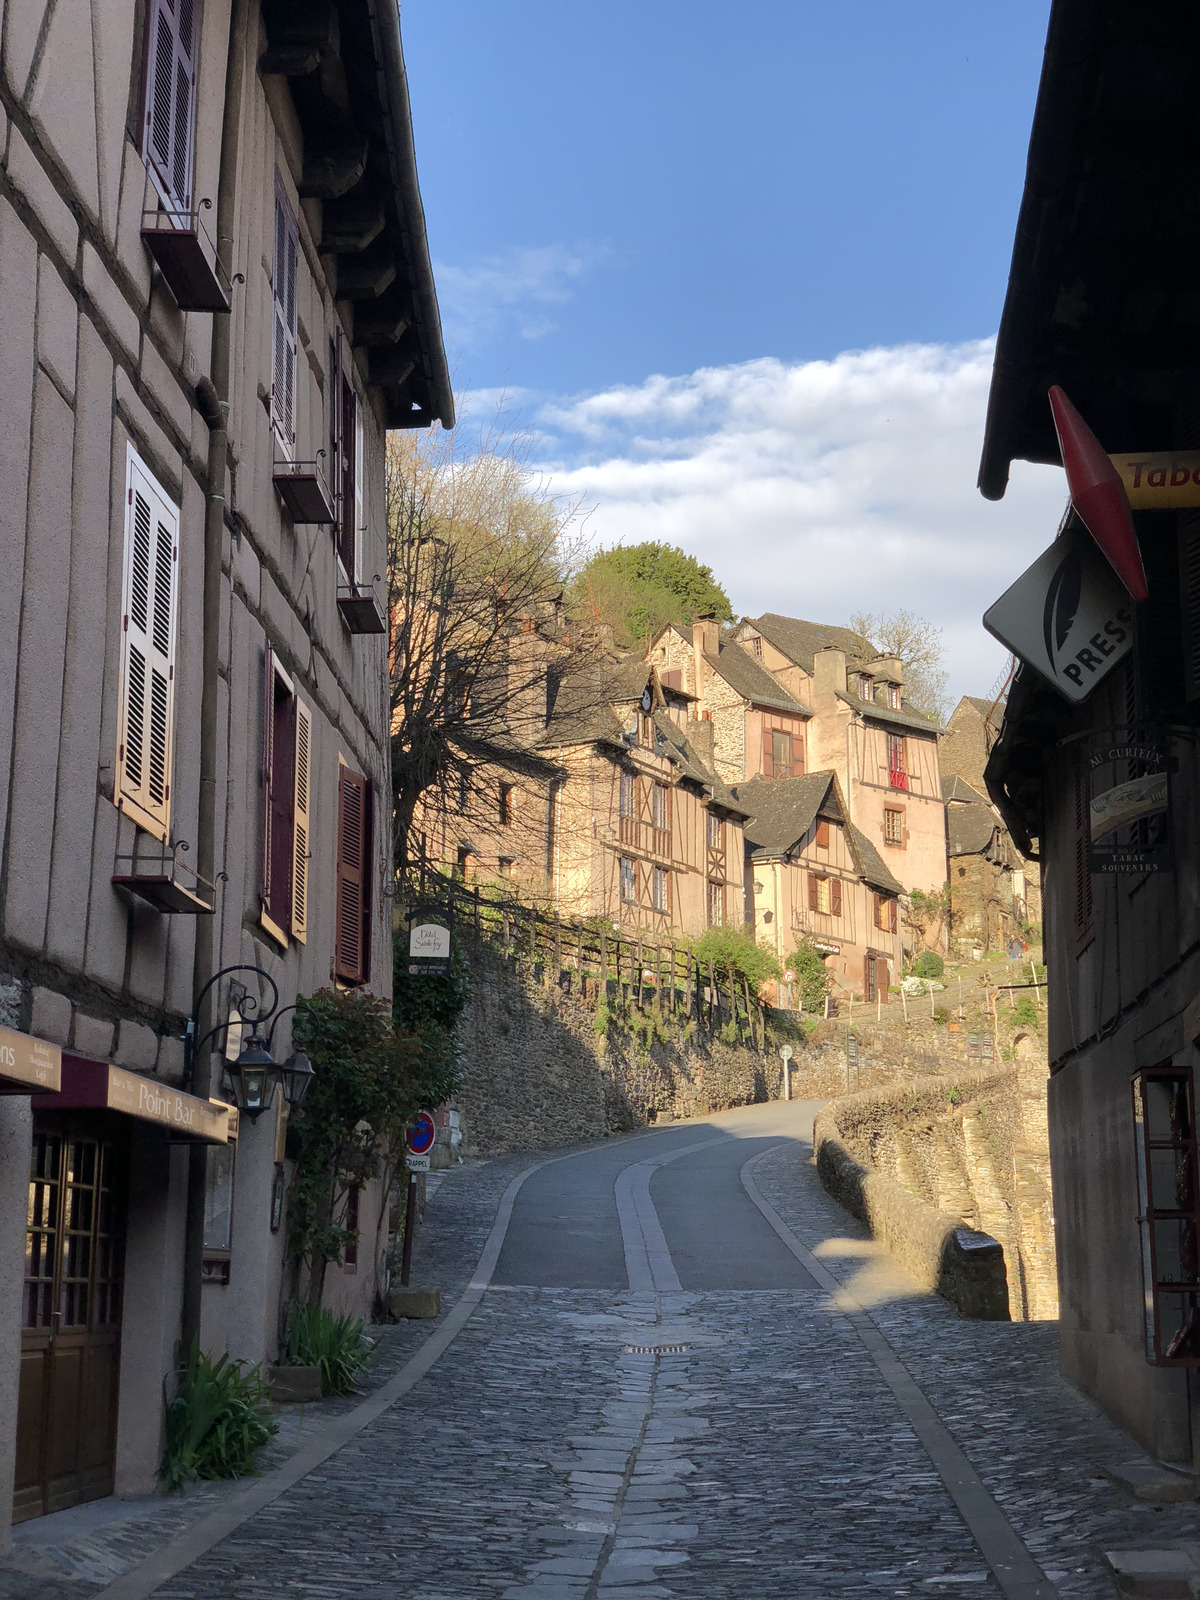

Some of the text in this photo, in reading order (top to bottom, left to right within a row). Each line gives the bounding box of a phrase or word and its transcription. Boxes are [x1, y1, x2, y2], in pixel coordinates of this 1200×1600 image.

[1089, 747, 1164, 768] AU CURIEUX
[1112, 854, 1145, 862] TABAC
[1101, 863, 1159, 872] SOUVENIRS
[138, 1083, 171, 1119] Point
[174, 1097, 195, 1125] Bar
